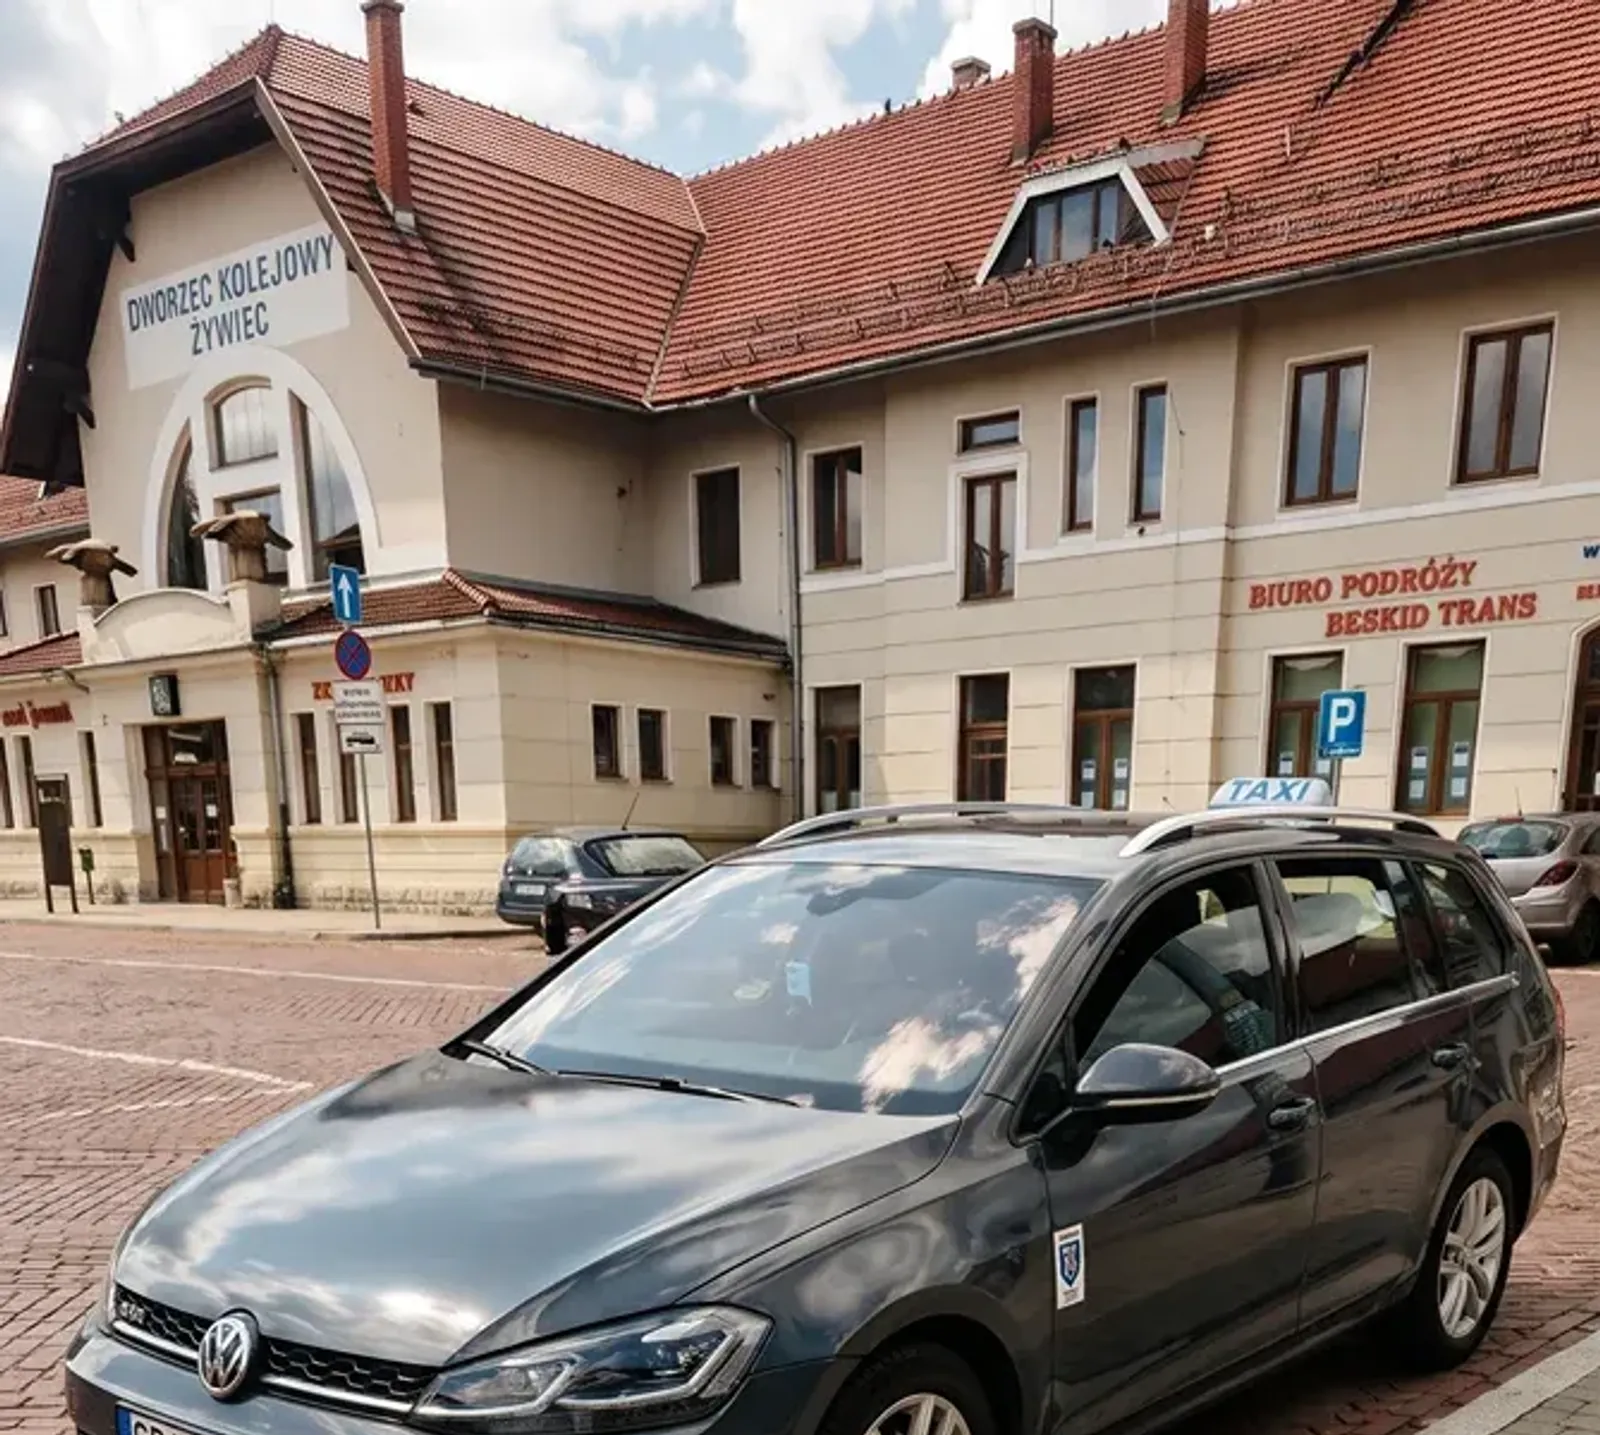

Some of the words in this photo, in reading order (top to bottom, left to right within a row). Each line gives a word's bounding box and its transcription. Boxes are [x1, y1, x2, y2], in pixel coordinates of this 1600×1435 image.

[127, 273, 213, 331] DWORZEC
[218, 234, 333, 301] KOLEJOWY
[190, 301, 269, 355] ŻYWIEC
[1249, 577, 1333, 609] BIURO
[1341, 555, 1477, 599] PODRÓŻY
[1325, 603, 1429, 637] BESKID
[1438, 592, 1537, 627] TRANS
[1327, 697, 1356, 743] P
[1229, 778, 1310, 802] TAXI
